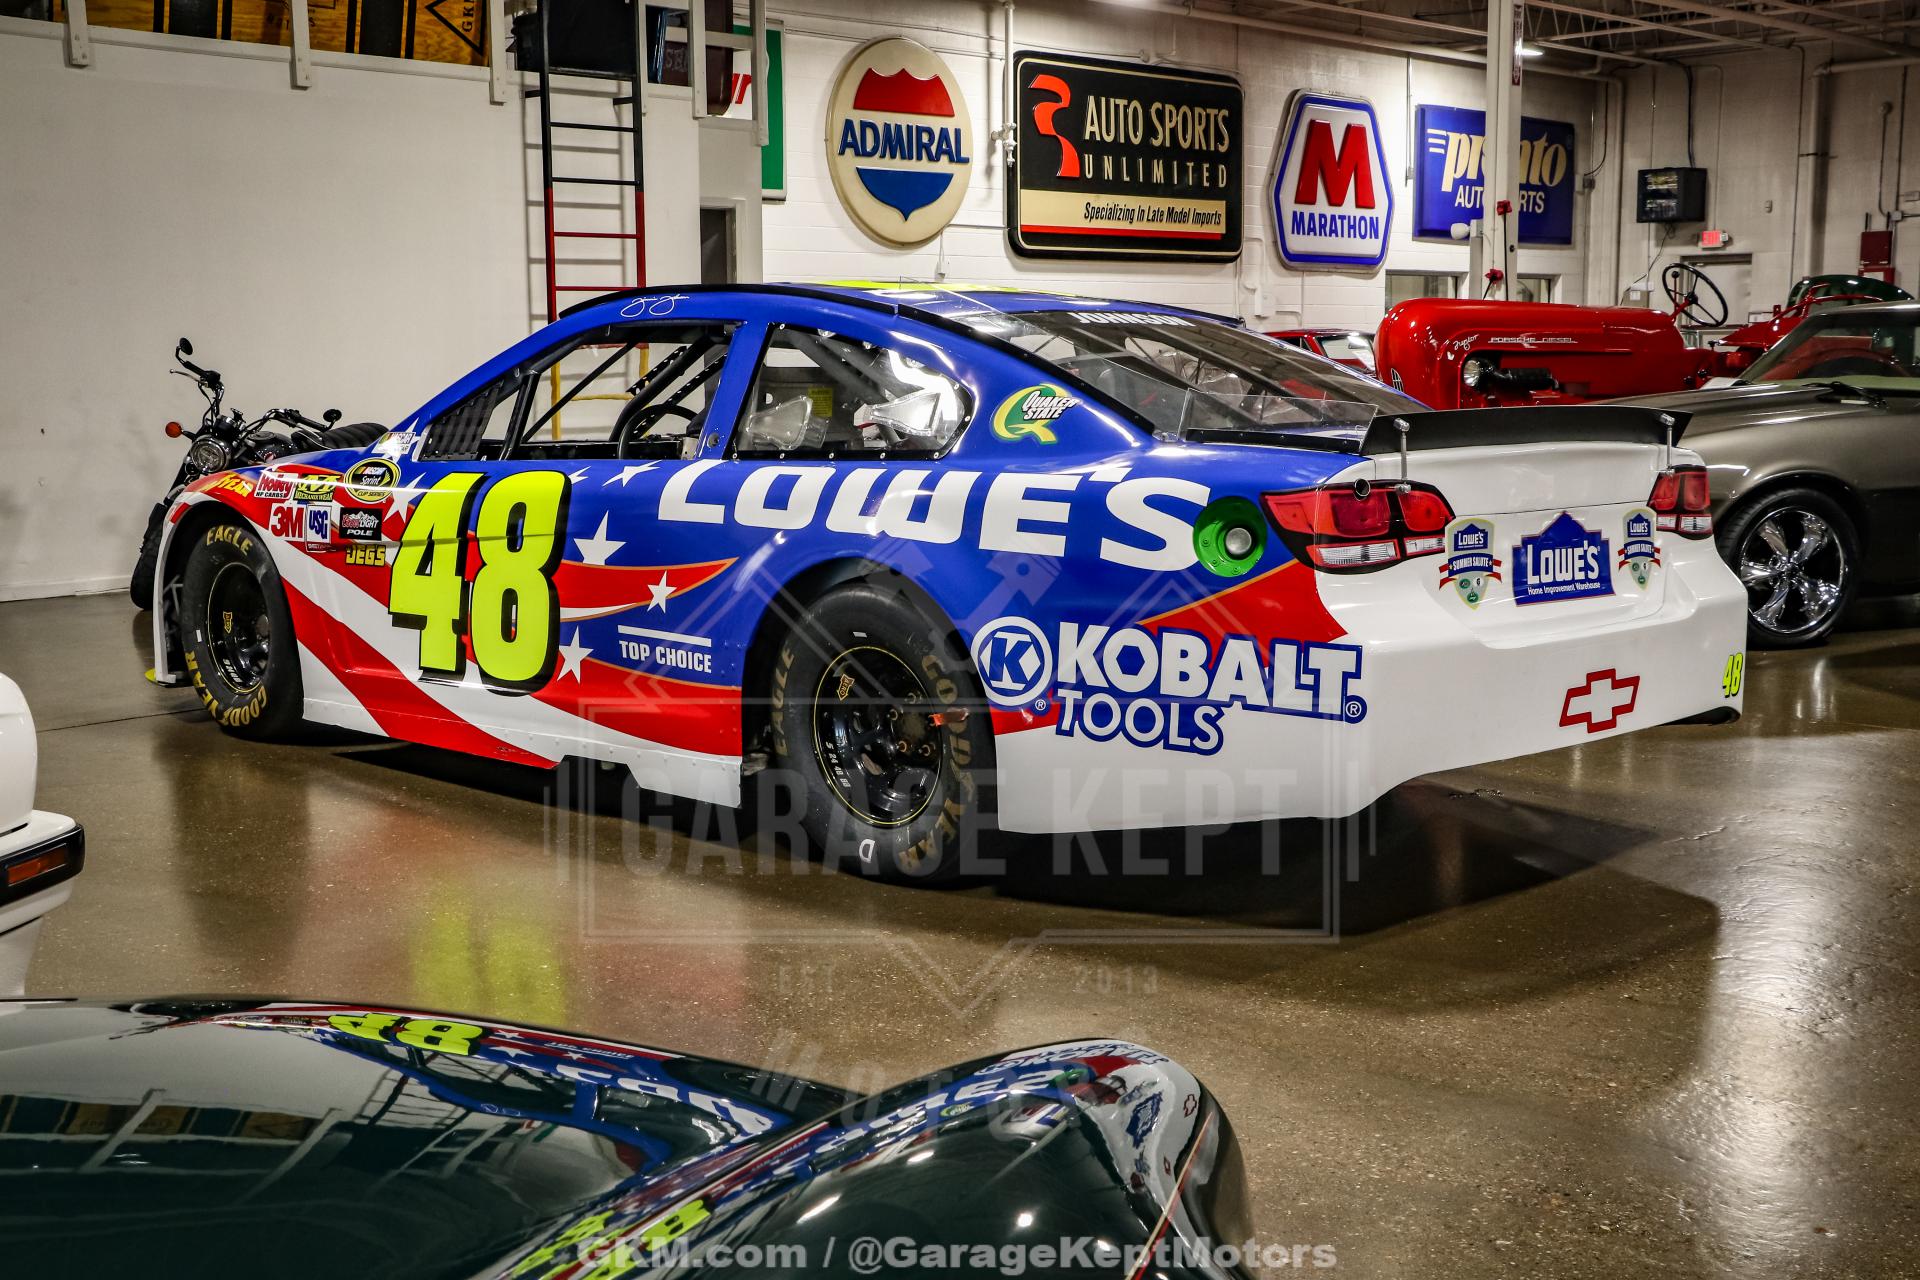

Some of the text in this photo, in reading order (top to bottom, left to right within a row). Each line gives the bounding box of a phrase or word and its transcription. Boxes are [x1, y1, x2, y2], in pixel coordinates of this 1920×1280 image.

[1084, 95, 1230, 153] AUTO SPORTS
[838, 118, 970, 164] ADMIRAL
[1084, 153, 1227, 188] UNLIMITED
[1294, 118, 1376, 209] M
[1084, 202, 1222, 227] Specializing In Late Model Imports
[1291, 211, 1379, 240] MARATHON
[1489, 336, 1573, 344] PORSCHE DIESEL
[1022, 390, 1079, 411] QUAKER
[1023, 406, 1064, 420] STATE
[357, 490, 370, 498] CUP
[360, 475, 381, 487] Sprint
[271, 506, 304, 539] 3M
[309, 510, 328, 539] USG
[359, 520, 380, 529] LIGHT
[658, 459, 1211, 572] LOWE'S
[1629, 520, 1648, 533] LOWE'S
[207, 525, 254, 556] EAGLE
[346, 529, 373, 537] POLE
[1458, 532, 1484, 545] LOWE'S
[1453, 556, 1489, 571] SUMMER SALUTE
[1527, 540, 1600, 584] LOWE'S
[388, 470, 573, 697] 48
[1527, 581, 1601, 595] Home Improvement Warehouse
[619, 640, 712, 674] TOP CHOICE
[1057, 620, 1358, 715] KOBALT
[184, 650, 269, 727] GOODYEAR
[840, 676, 854, 697] AERO
[1721, 652, 1744, 698] 48
[1060, 688, 1223, 750] TOOLS
